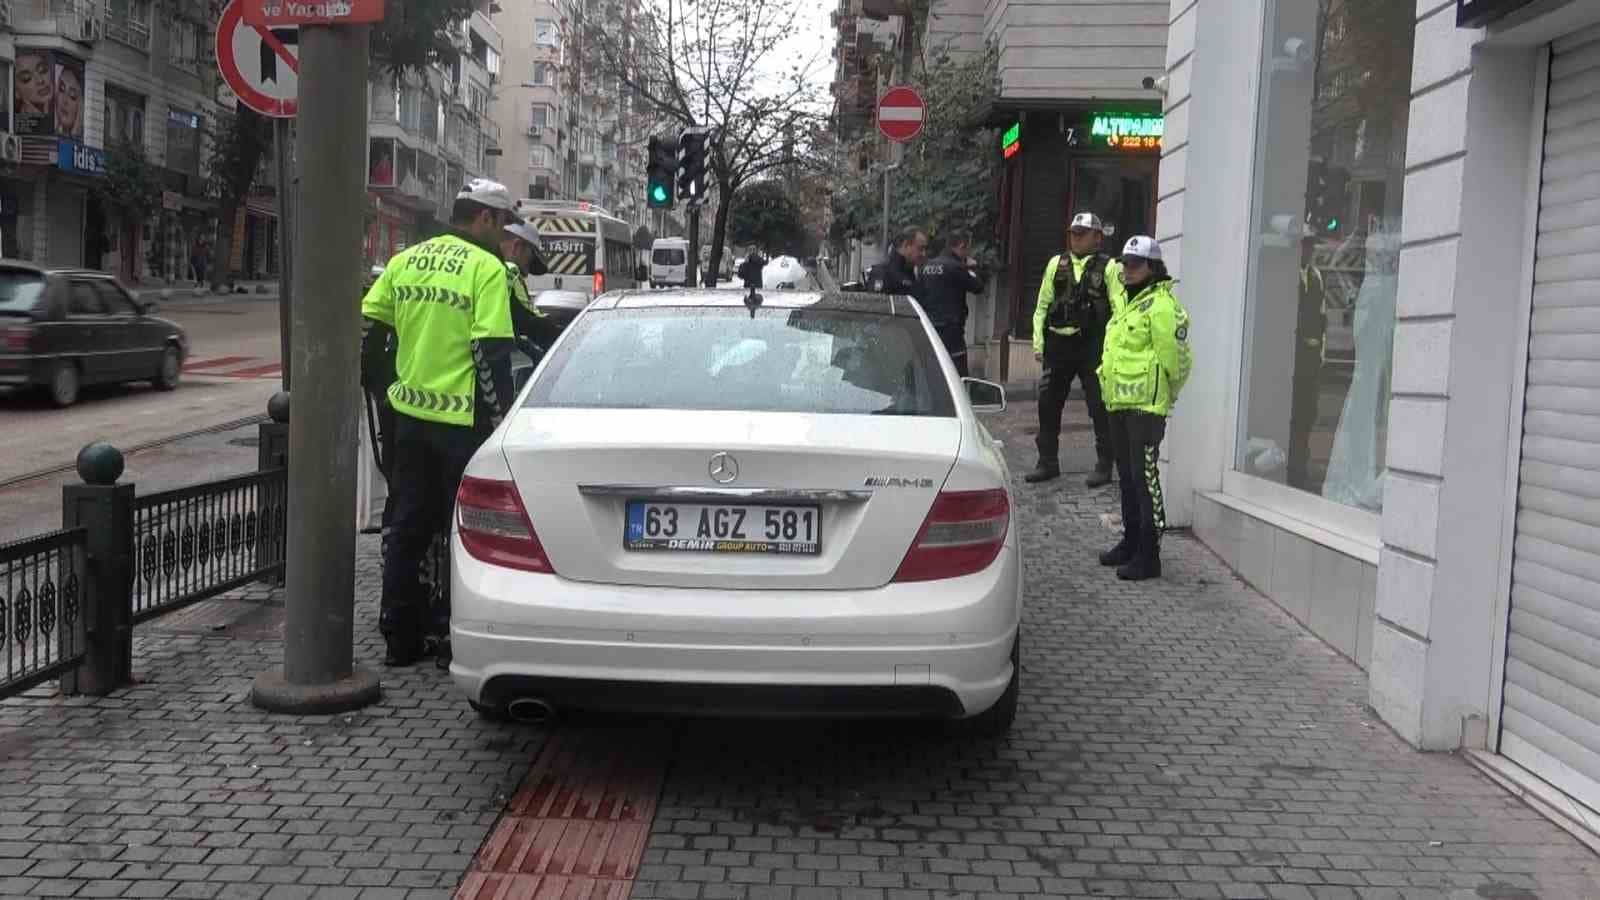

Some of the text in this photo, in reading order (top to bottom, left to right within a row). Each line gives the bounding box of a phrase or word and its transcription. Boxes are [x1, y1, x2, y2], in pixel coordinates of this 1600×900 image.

[646, 507, 813, 541] 63 AGZ 581
